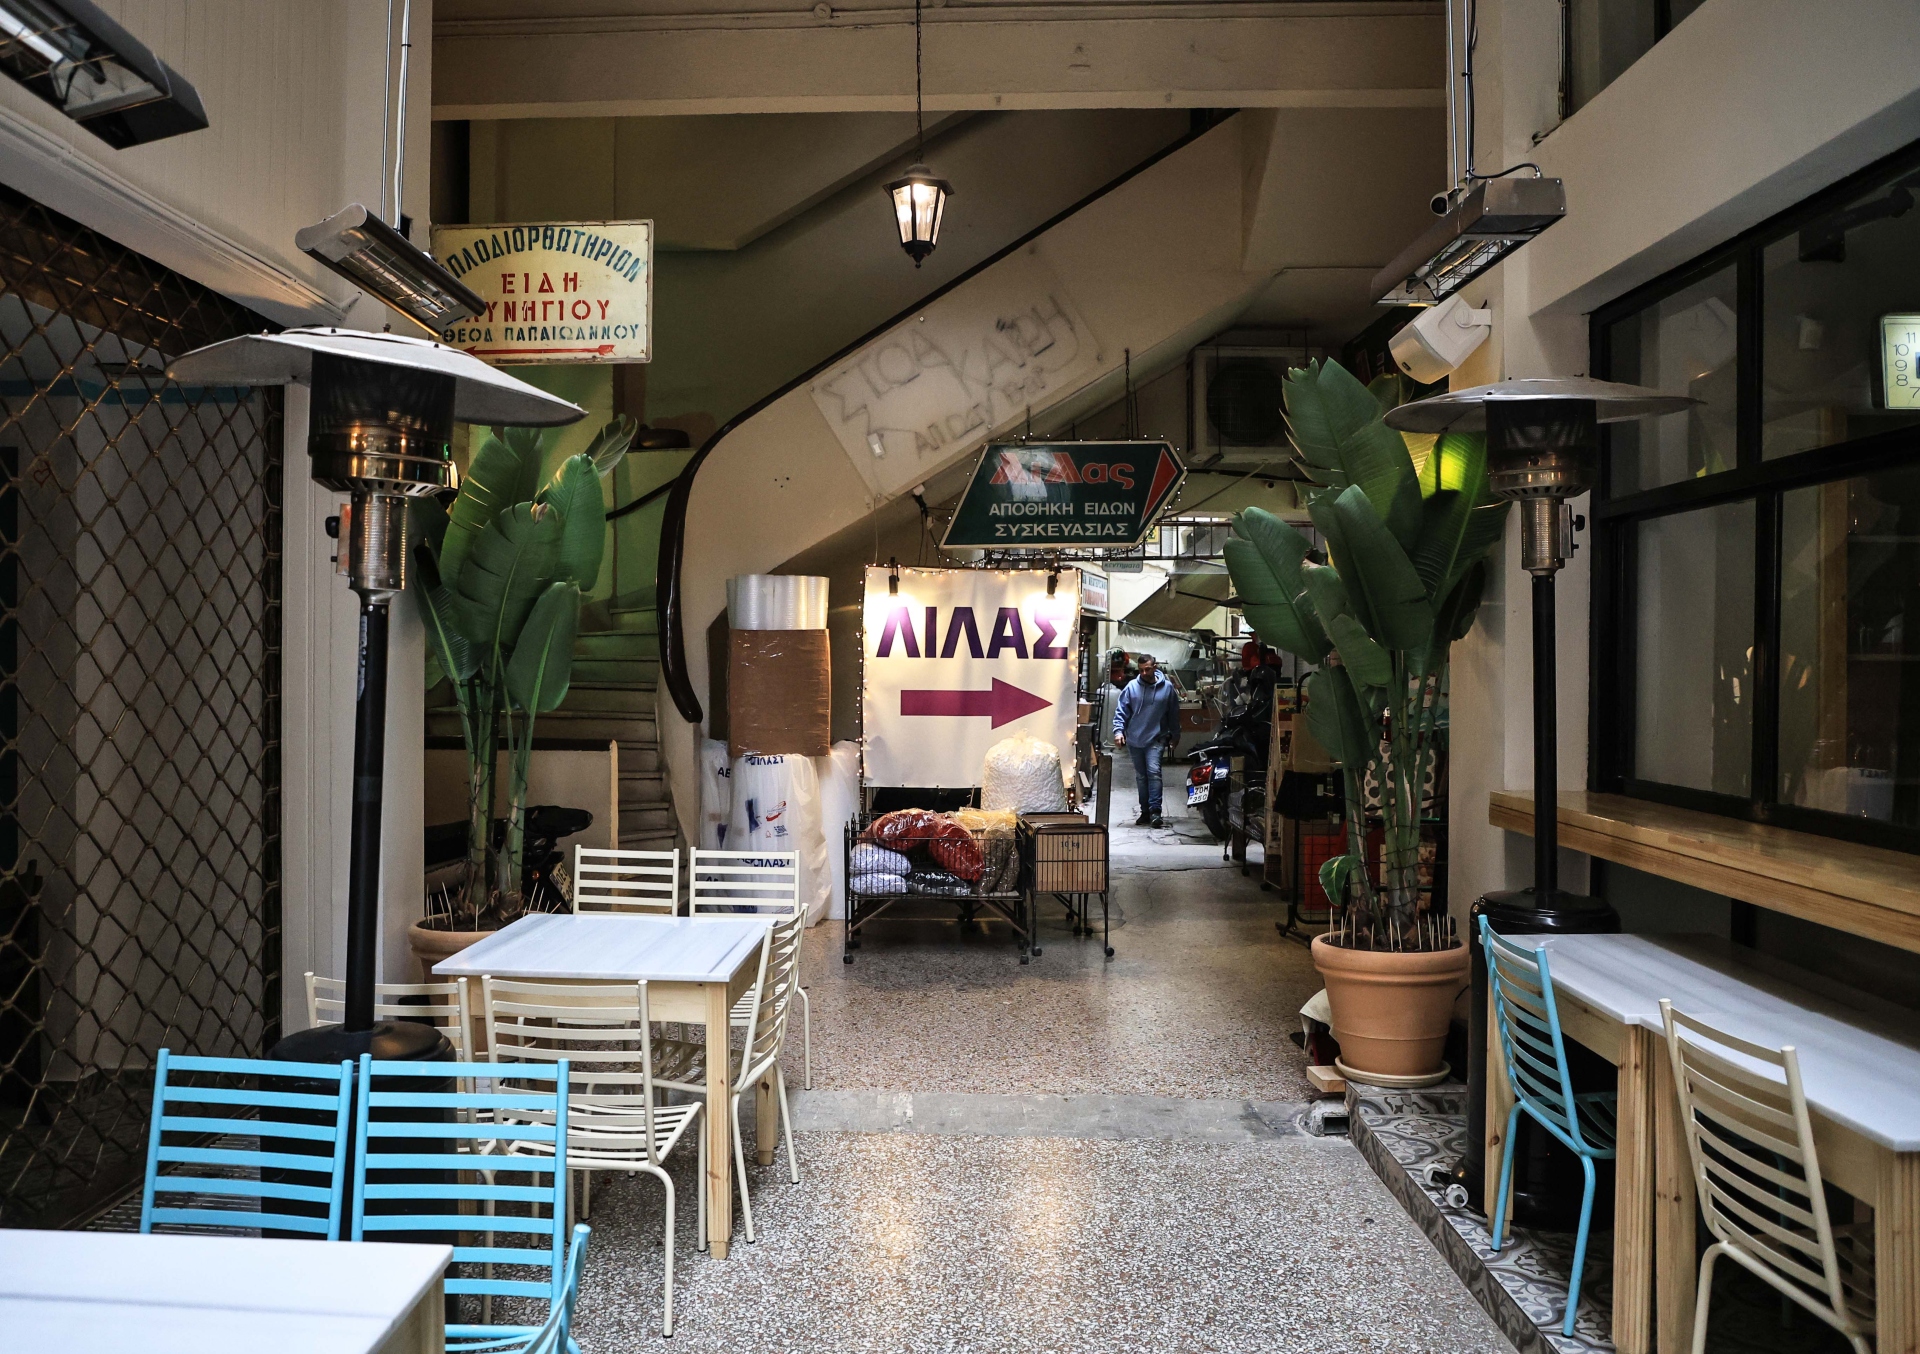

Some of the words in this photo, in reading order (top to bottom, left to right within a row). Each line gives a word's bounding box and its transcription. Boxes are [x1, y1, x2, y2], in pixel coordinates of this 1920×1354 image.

[432, 226, 646, 283] ΠΛΟΔΙΟΡΘΩΤΗΡΙΟΝ
[501, 272, 578, 294] ΕΙΔΗ
[504, 324, 639, 342] ΠΑΠΑΙΩΑΝΝΟΥ
[1905, 332, 1916, 344] 11
[1893, 343, 1909, 357] 10
[1895, 359, 1908, 372] 9
[1896, 374, 1909, 387] 8
[989, 502, 1074, 516] ΑΠΟΘΗΚΗ
[1085, 502, 1135, 515] ΕΙΔΩΝ
[995, 523, 1128, 537] ΣΥΣΚΕΥΑΣΙΑΣ
[876, 606, 1068, 660] ΛΙΛΑΣ
